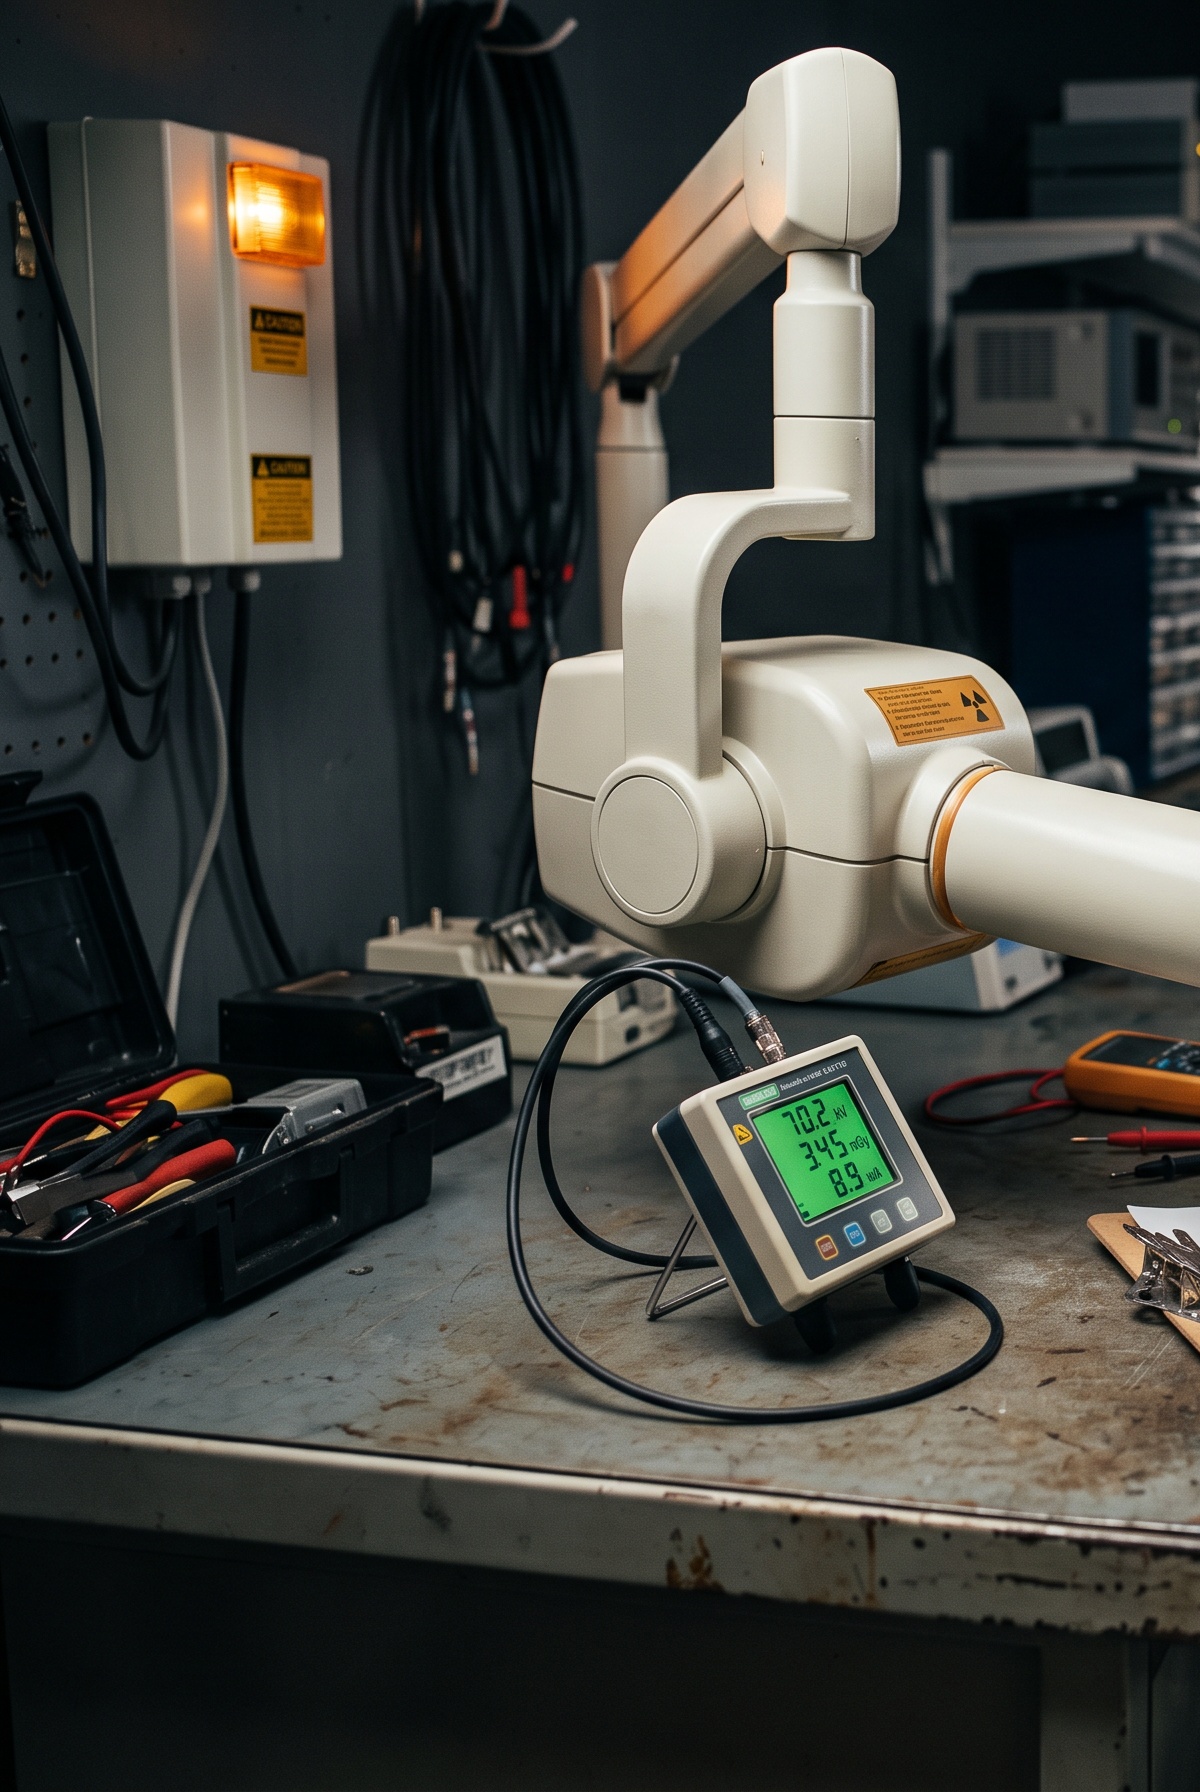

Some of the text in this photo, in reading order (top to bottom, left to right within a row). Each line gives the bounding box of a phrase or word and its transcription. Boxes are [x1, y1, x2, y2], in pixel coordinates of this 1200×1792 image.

[781, 1098, 848, 1135] 70.2 kV
[799, 1129, 849, 1171] 3.45
[828, 1161, 864, 1198] 8.9
